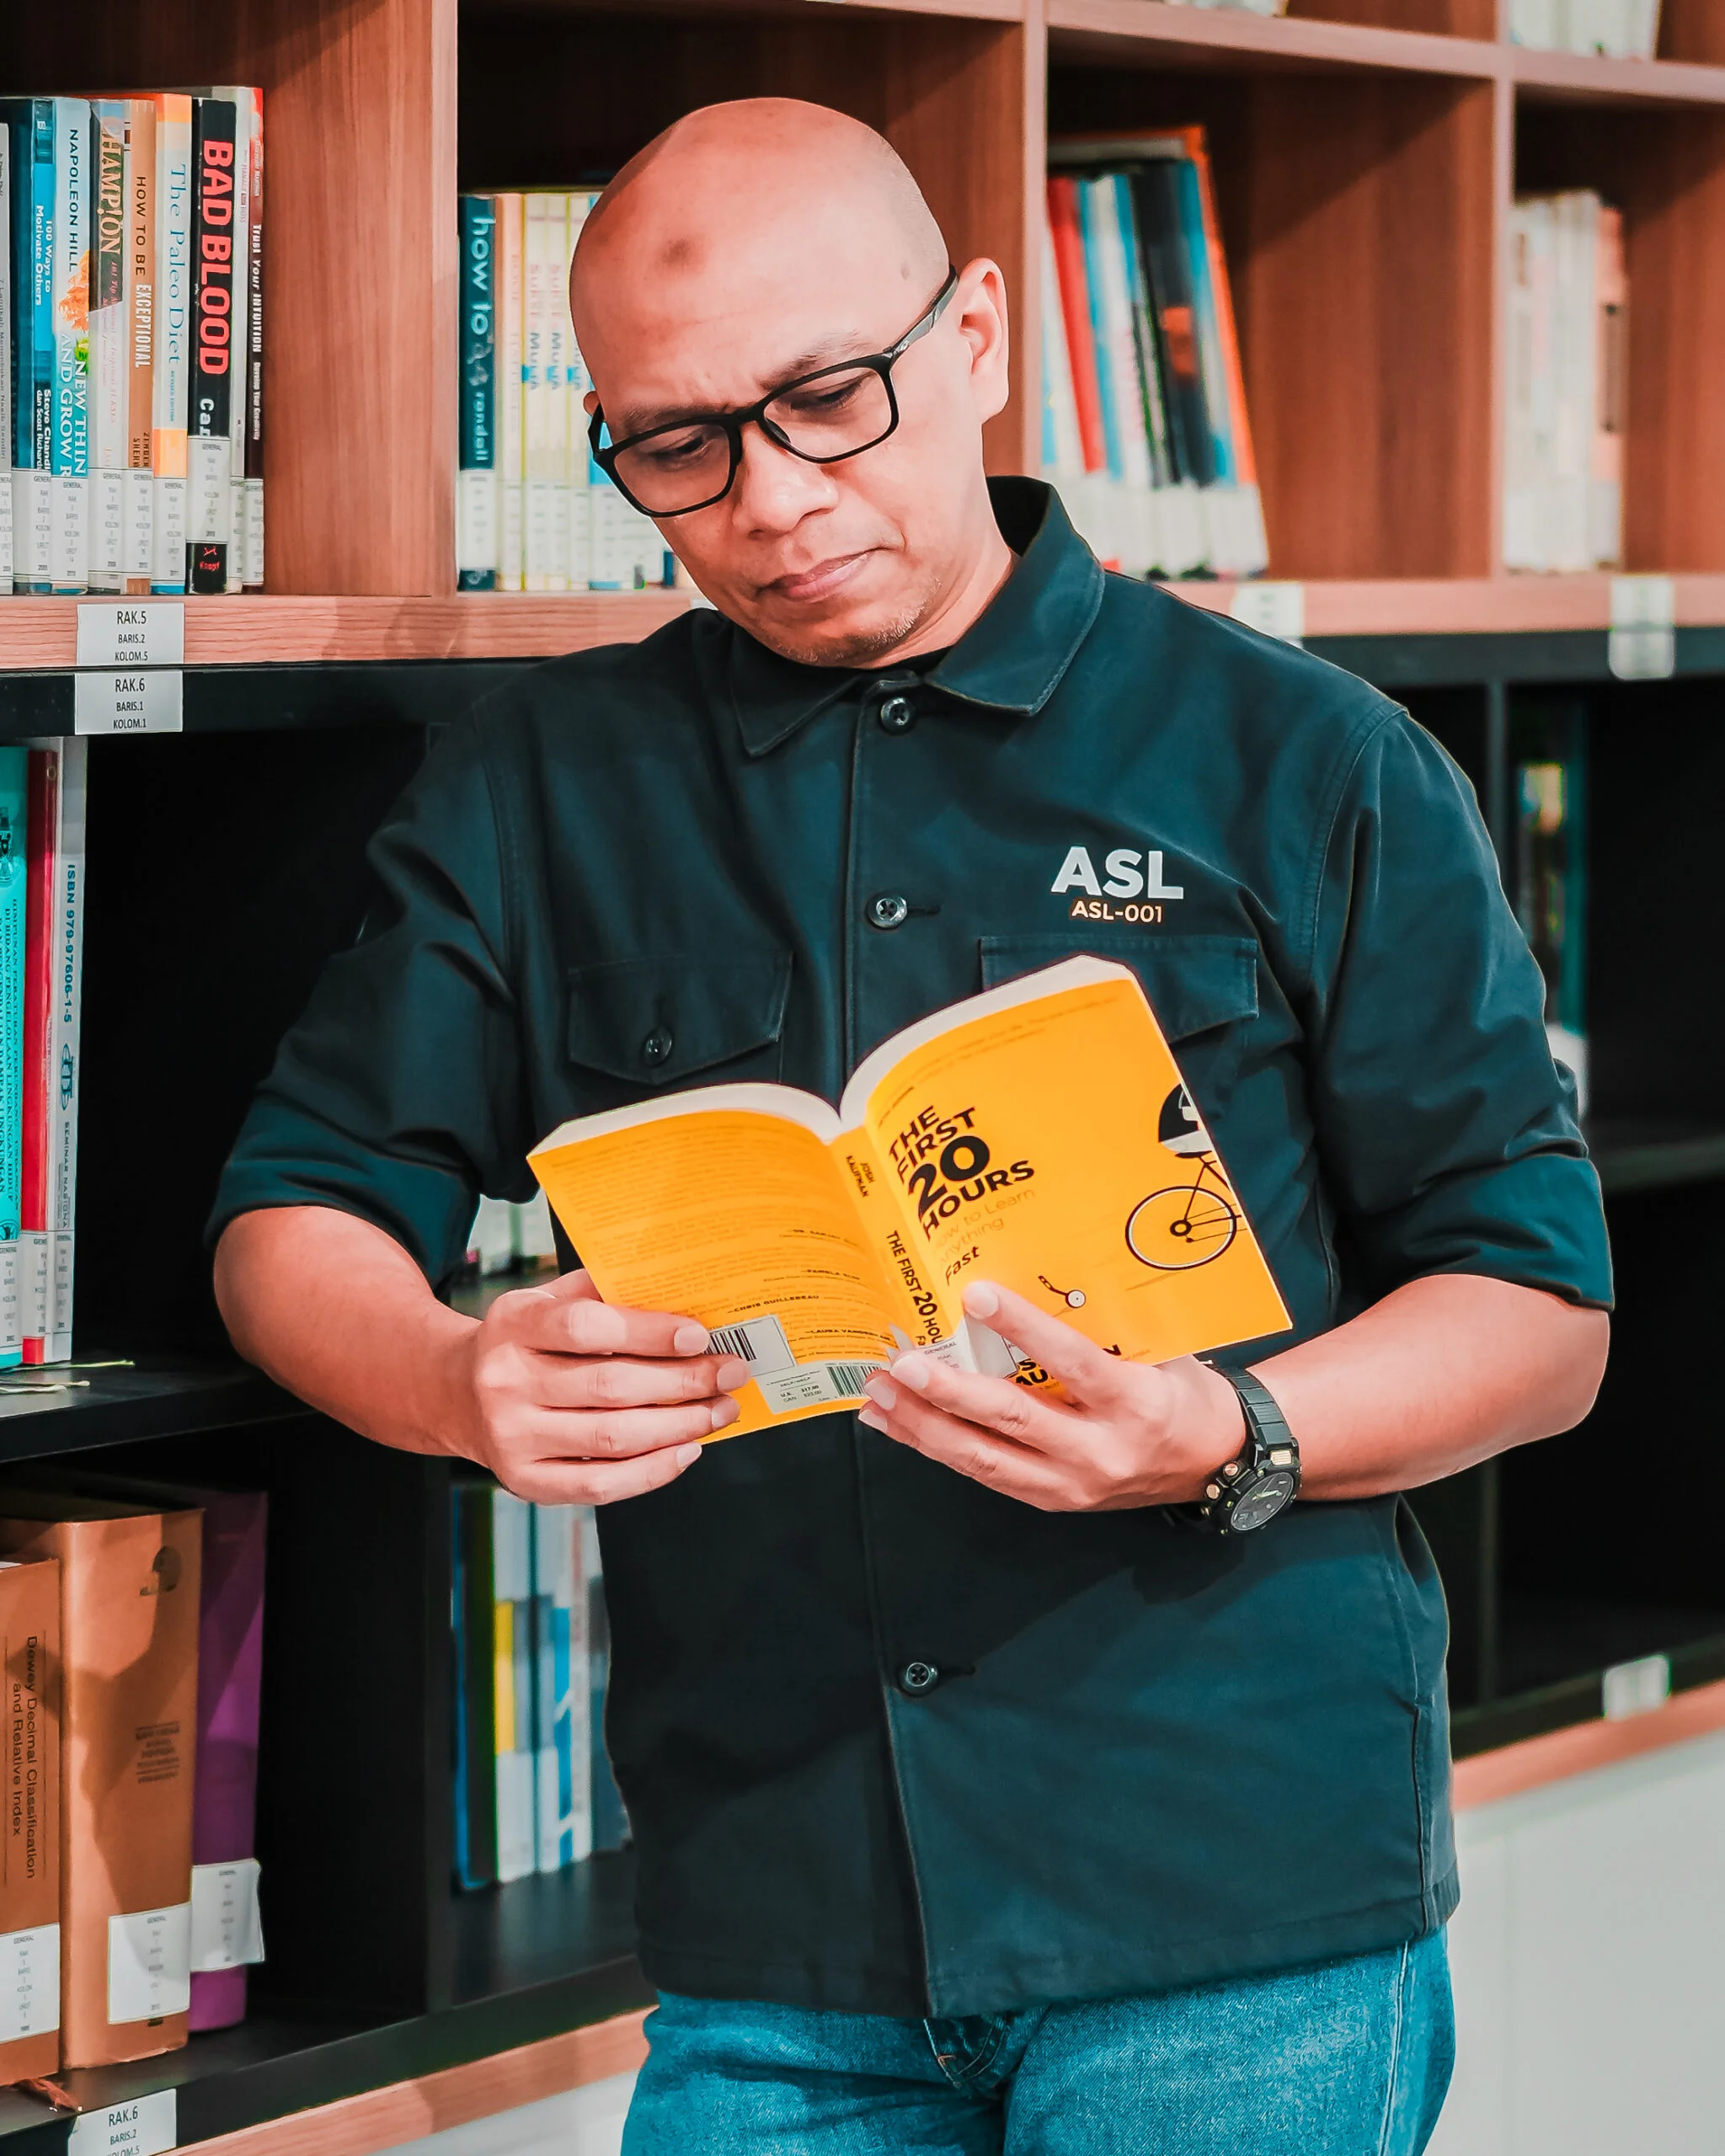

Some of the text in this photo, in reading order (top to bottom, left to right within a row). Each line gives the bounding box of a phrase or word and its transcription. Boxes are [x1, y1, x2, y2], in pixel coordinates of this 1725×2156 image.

[70, 129, 78, 272] NAPOLEON HILL
[35, 205, 44, 259] Motivate
[136, 176, 147, 276] HOW TO BE
[44, 245, 52, 275] Ways
[168, 164, 186, 364] The Paleo Diet
[200, 140, 233, 375] BAD BLOOD
[471, 215, 496, 291] how
[45, 280, 52, 292] to
[252, 224, 262, 352] Trust Your INTUITION
[135, 284, 152, 367] EXCEPTIONAL
[471, 302, 493, 335] to
[61, 334, 72, 382] AND
[61, 388, 72, 458] GROW
[74, 360, 87, 473] NEW THIN
[132, 438, 141, 468] SHERW
[116, 611, 147, 625] RAK.5
[118, 634, 145, 643] BARIS.2
[115, 651, 148, 661] KOLOM.5
[115, 678, 145, 692] RAK.6
[116, 702, 143, 712] BARIS.1
[113, 718, 147, 729] KOLOM.1
[1050, 846, 1184, 899] ASL
[5, 909, 10, 921] DI
[1071, 900, 1162, 923] ASL-001
[64, 864, 76, 1022] ISBN 979-97606-1-5
[889, 1105, 939, 1161] THE
[897, 1107, 975, 1185] FIRST
[908, 1135, 991, 1223] 20
[923, 1160, 1034, 1241] HOURS
[963, 1210, 982, 1225] to
[984, 1189, 1036, 1214] Learn
[940, 1216, 1005, 1263] nything
[886, 1230, 943, 1344] THE FIRST 20 HOU
[916, 1335, 927, 1346] Fa
[13, 1683, 24, 1836] and Relative Index
[25, 1636, 38, 1878] Dewey Decimal Classification
[109, 2105, 138, 2127] RAK.6
[109, 2129, 137, 2146] BARIS.2
[107, 2145, 140, 2156] OLOM.5
